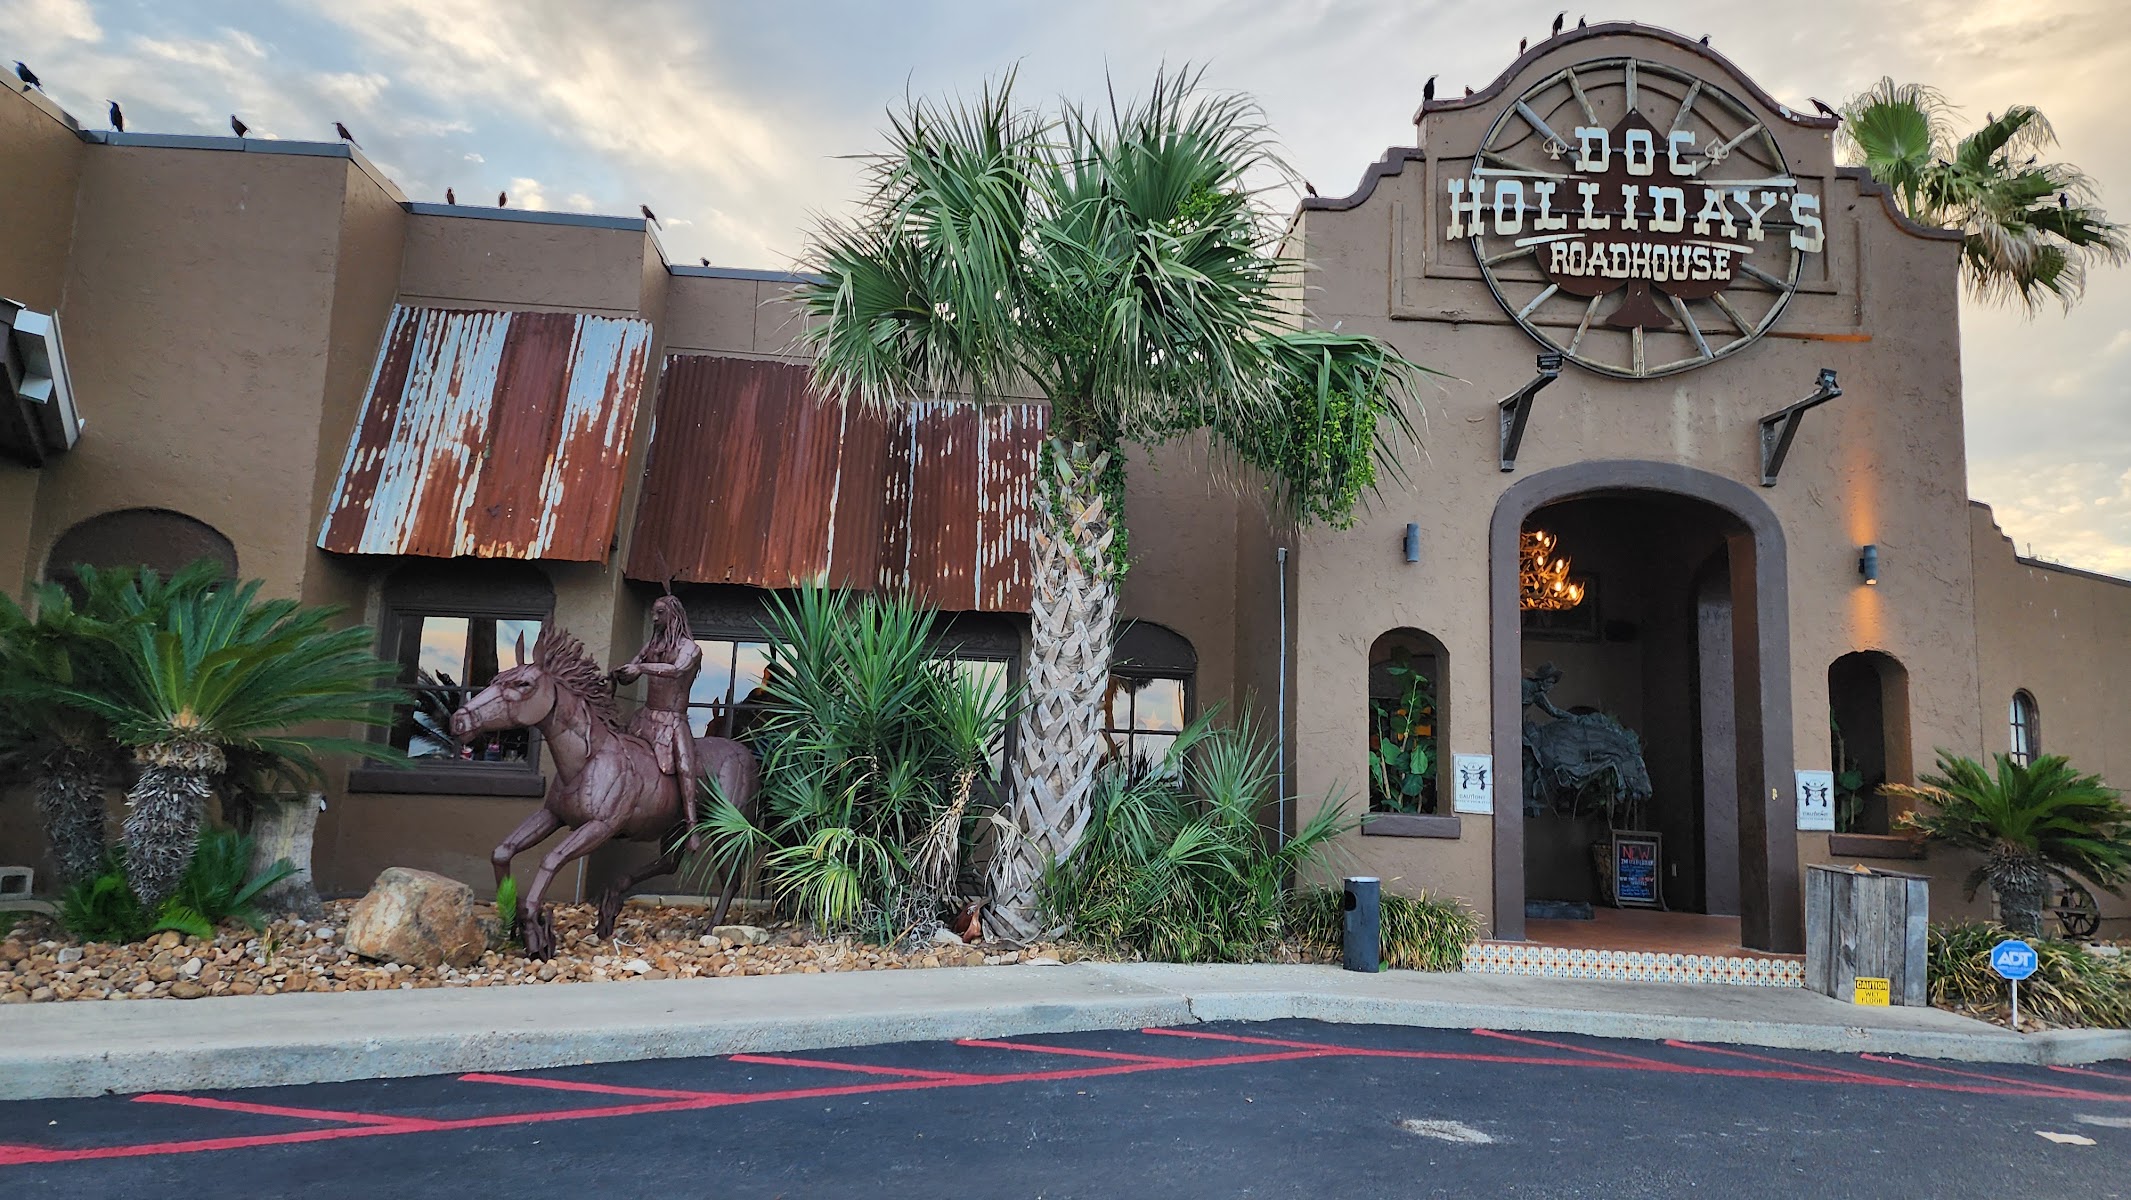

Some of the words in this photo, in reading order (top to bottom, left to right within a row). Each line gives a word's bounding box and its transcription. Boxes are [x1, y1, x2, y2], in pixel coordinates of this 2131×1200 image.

[1575, 126, 1697, 177] DOC
[1446, 177, 1825, 253] HOLLIDAY'S
[1549, 241, 1732, 282] ROADHOUSE
[1997, 951, 2033, 967] ADT
[1856, 980, 1888, 990] CAUTION
